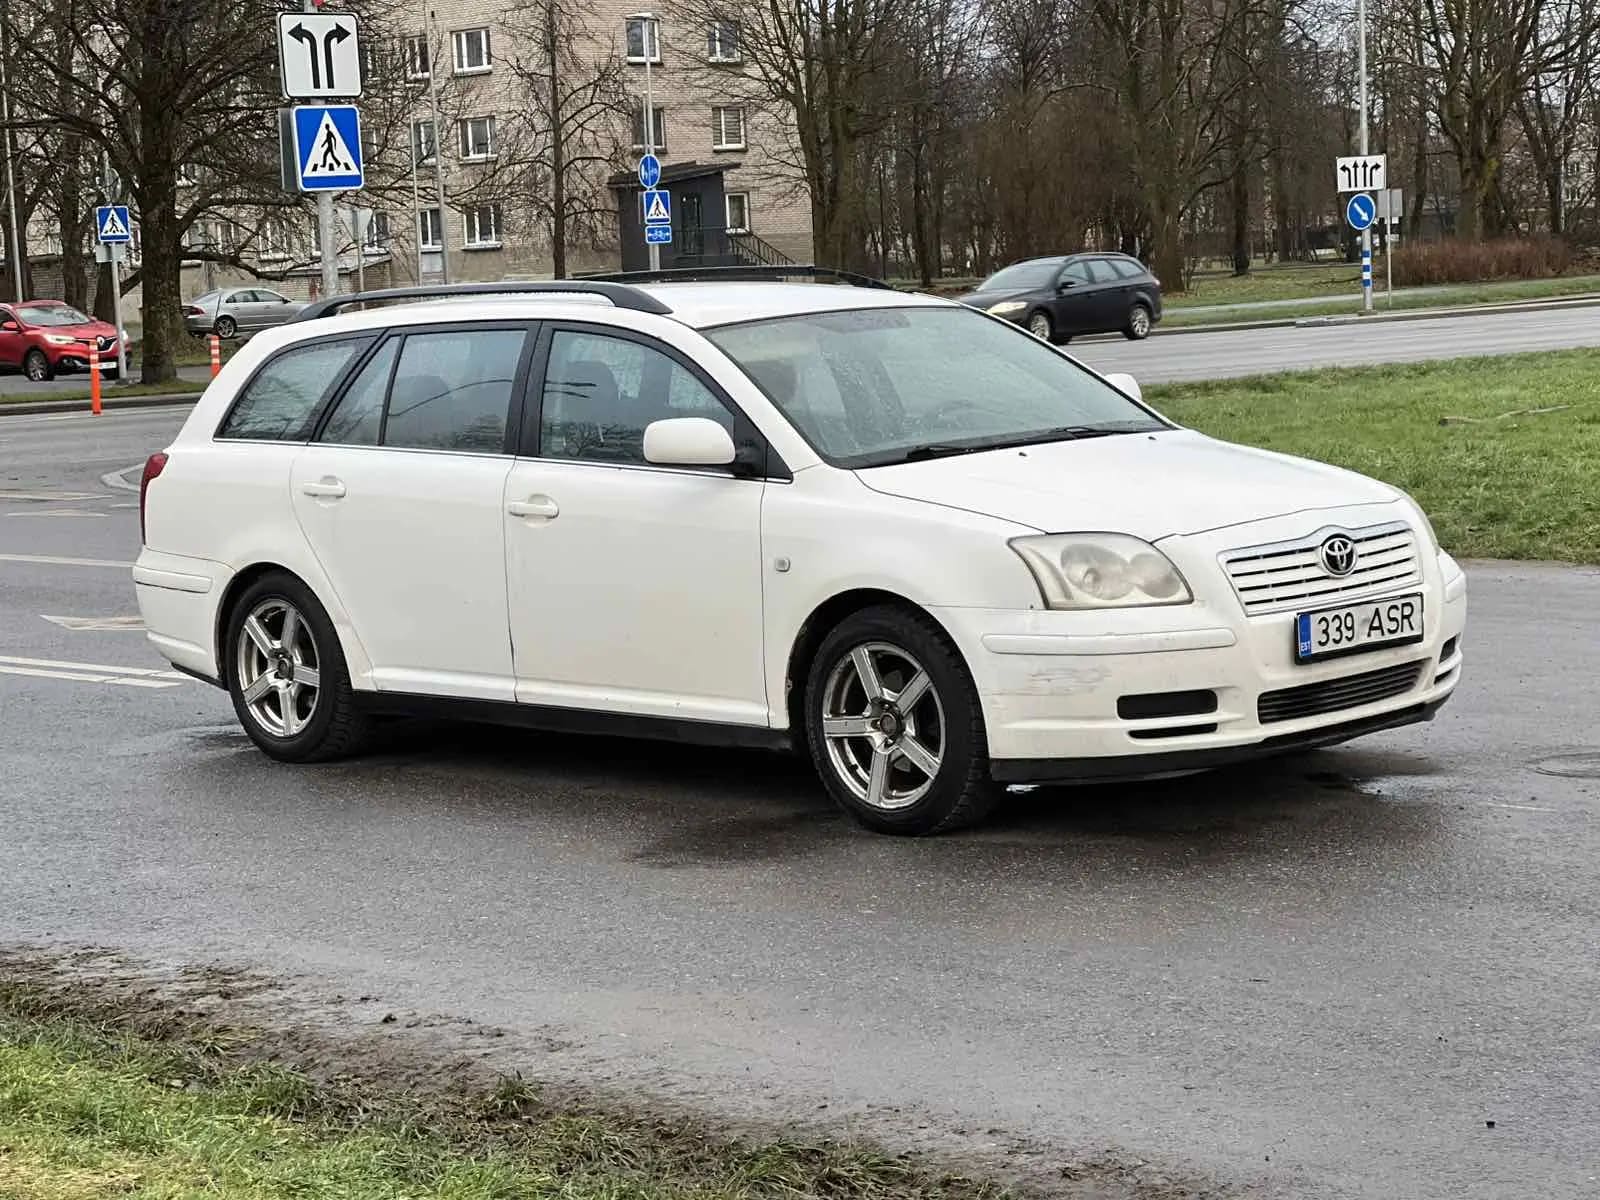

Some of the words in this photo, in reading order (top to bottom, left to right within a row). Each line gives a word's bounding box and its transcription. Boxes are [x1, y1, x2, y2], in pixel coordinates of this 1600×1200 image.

[1317, 612, 1355, 646] 339
[1367, 602, 1414, 638] ASR
[1300, 640, 1311, 652] EST
